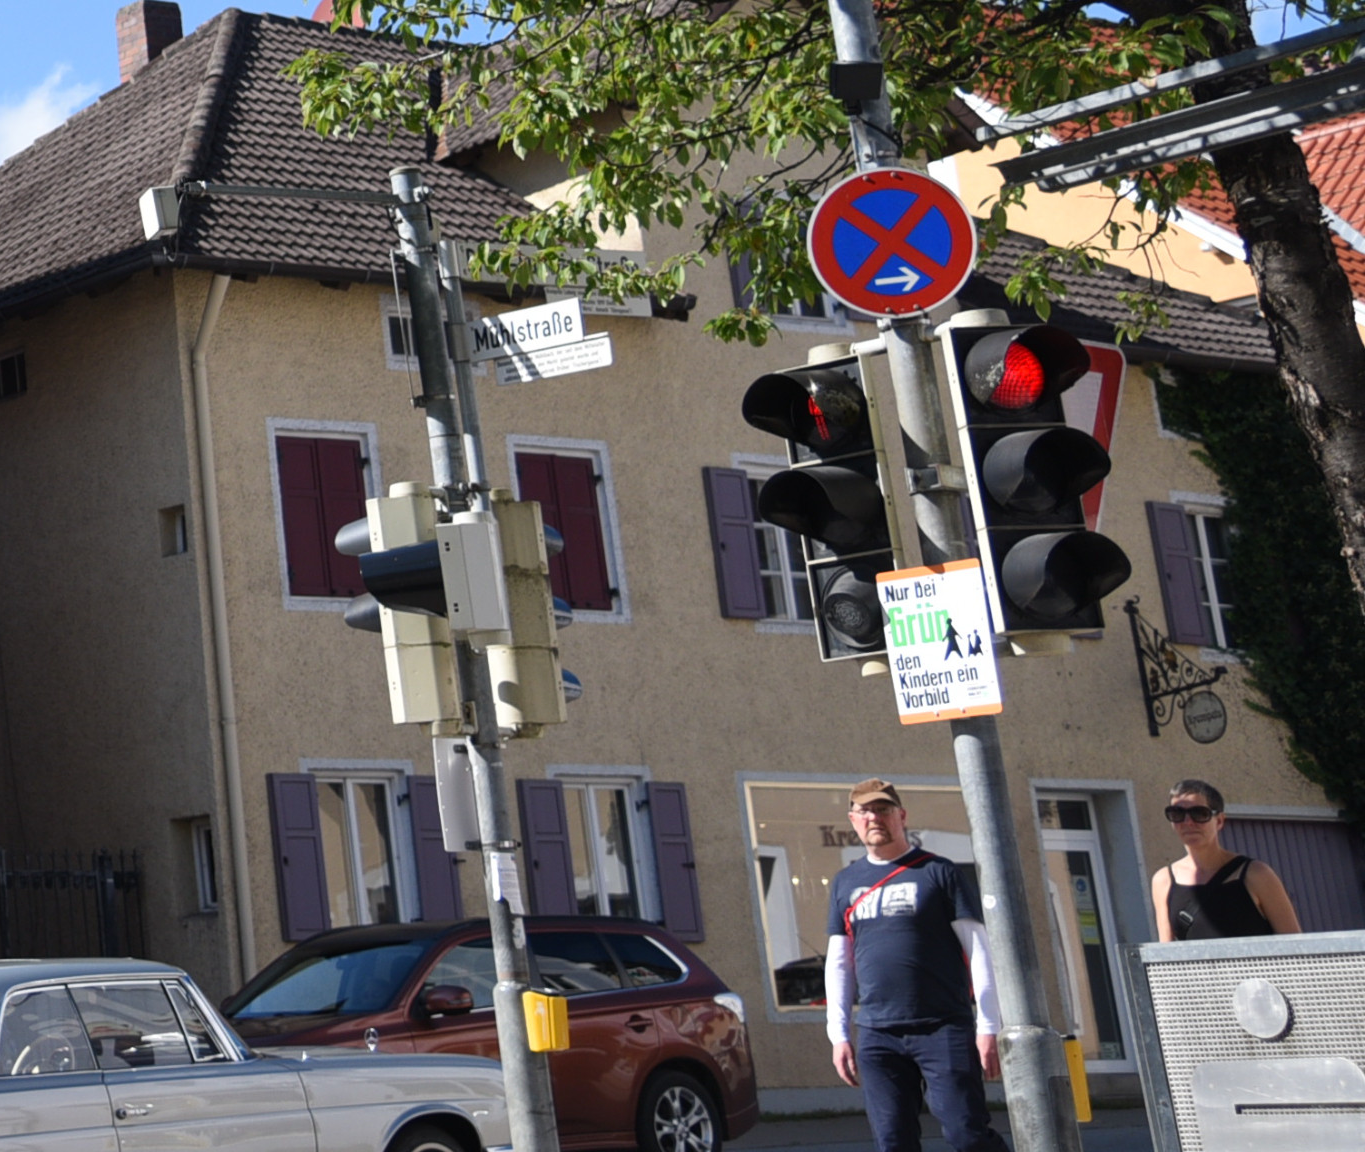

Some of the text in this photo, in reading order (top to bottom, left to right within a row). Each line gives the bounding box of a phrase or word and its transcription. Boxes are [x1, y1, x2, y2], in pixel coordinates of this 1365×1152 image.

[474, 311, 573, 352] Mühlstraße
[885, 579, 936, 603] Nur bei
[888, 603, 950, 647] Grün
[896, 653, 921, 671] den
[899, 664, 978, 690] Kindern ein
[902, 688, 950, 709] Vorbild
